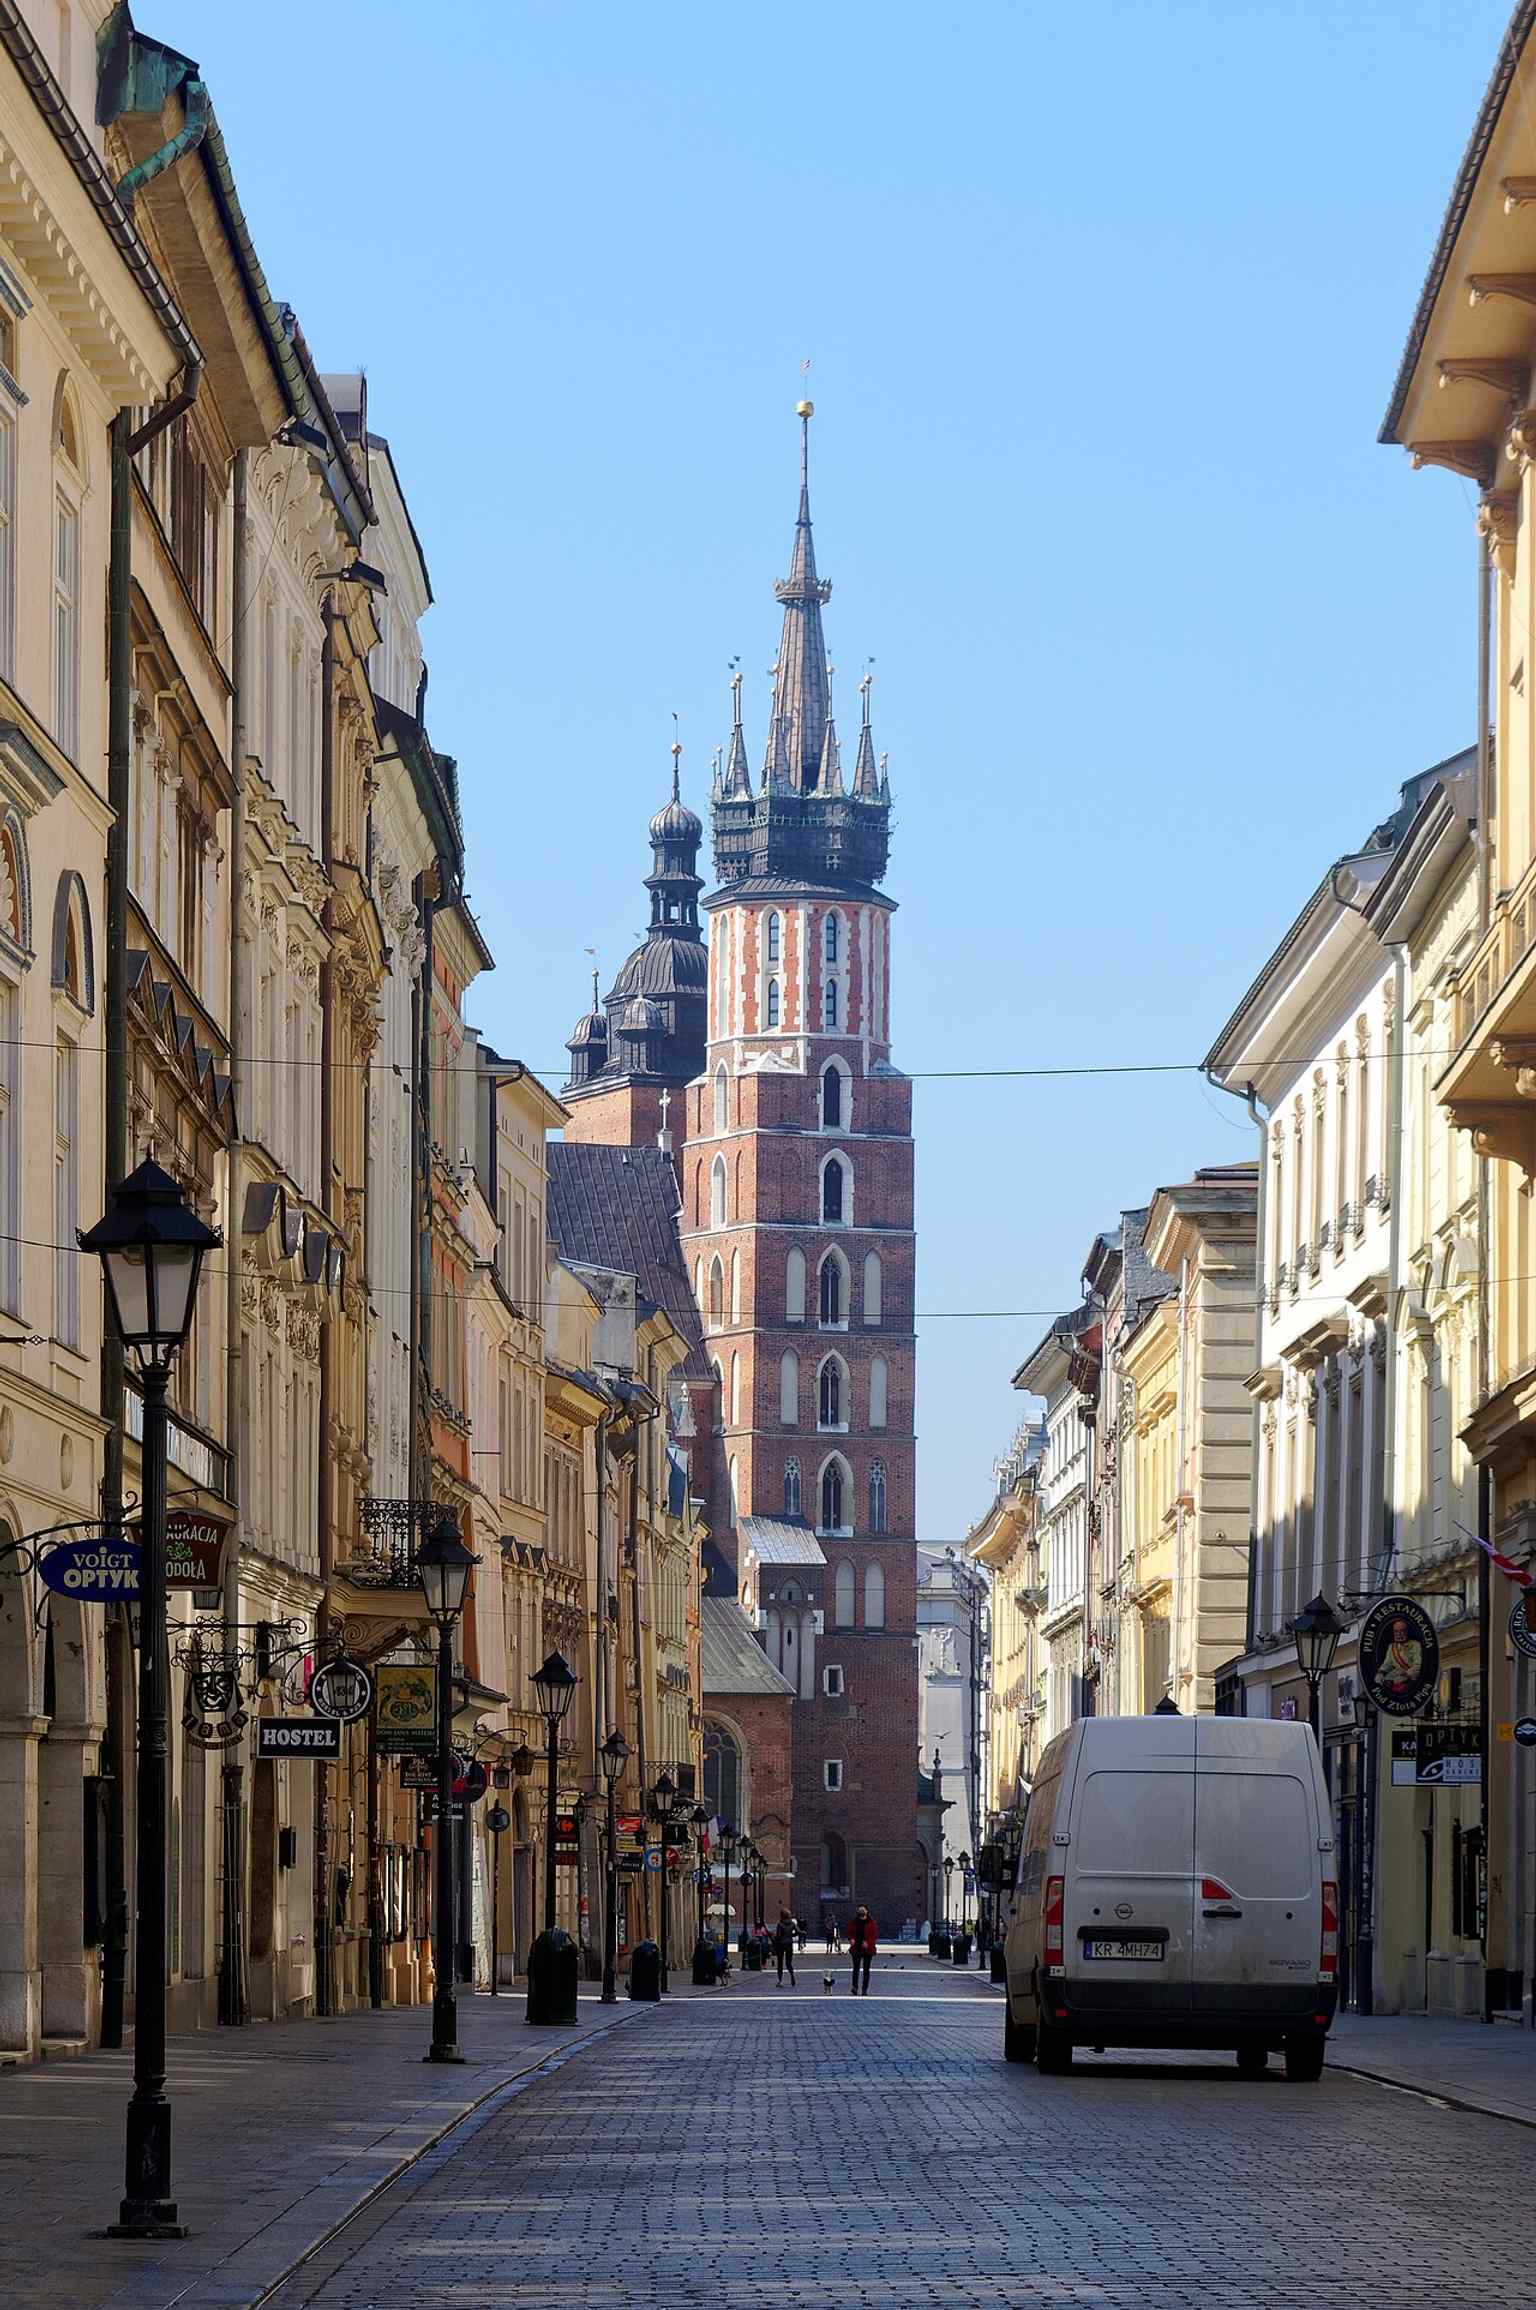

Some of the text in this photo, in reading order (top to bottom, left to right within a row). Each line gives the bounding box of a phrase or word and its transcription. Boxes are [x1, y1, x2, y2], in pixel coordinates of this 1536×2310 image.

[73, 1547, 133, 1568] VOIGT
[63, 1569, 139, 1589] OPTYK
[165, 1561, 206, 1580] ODOŁA
[1363, 1602, 1434, 1652] PUB RESTAURACJA
[262, 1729, 336, 1747] HOSTEL
[1425, 1728, 1479, 1748] OPTYK
[1094, 1943, 1112, 1956] KR
